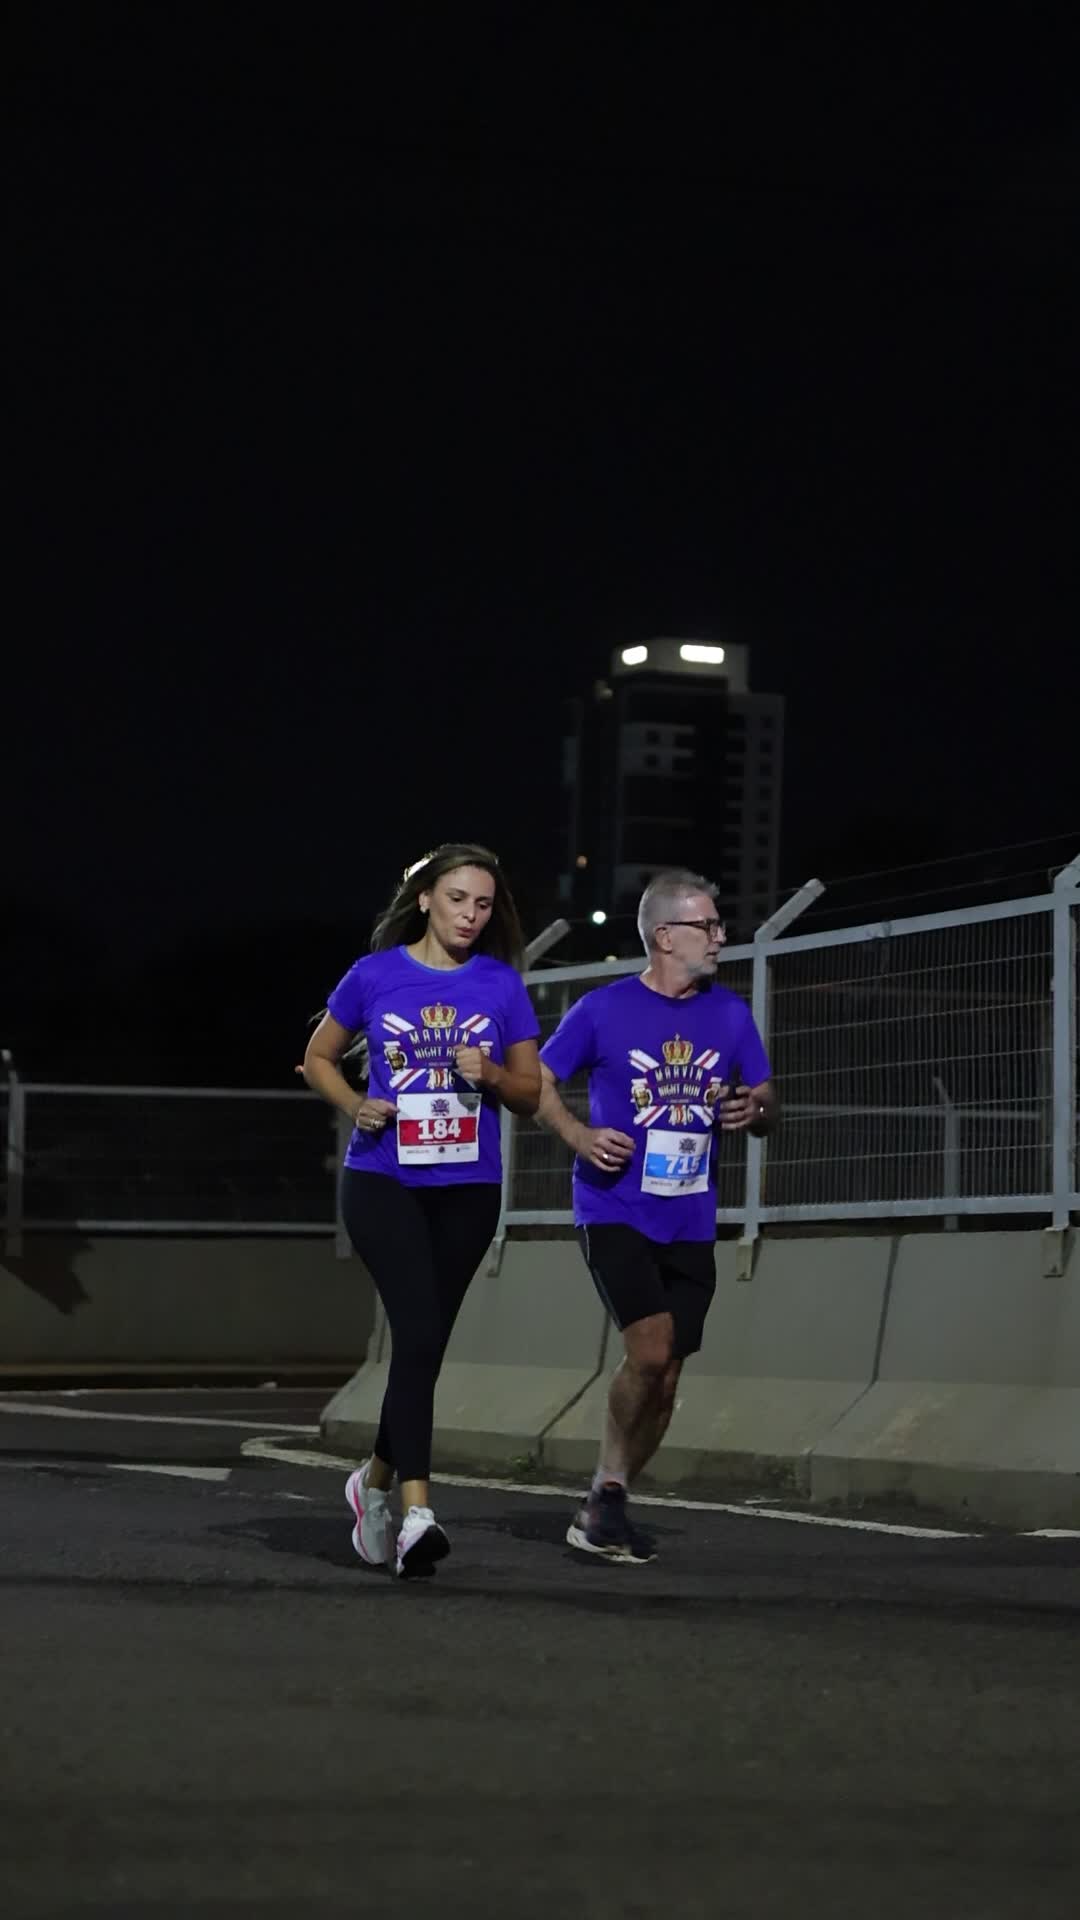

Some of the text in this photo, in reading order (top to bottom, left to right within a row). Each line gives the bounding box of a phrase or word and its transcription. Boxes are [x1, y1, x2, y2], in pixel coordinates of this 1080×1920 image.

[409, 1028, 469, 1045] MARVIN
[414, 1046, 442, 1060] NIGHT
[655, 1065, 704, 1081] MARVIN
[658, 1083, 701, 1097] NIGHT RUN
[418, 1119, 461, 1140] 184
